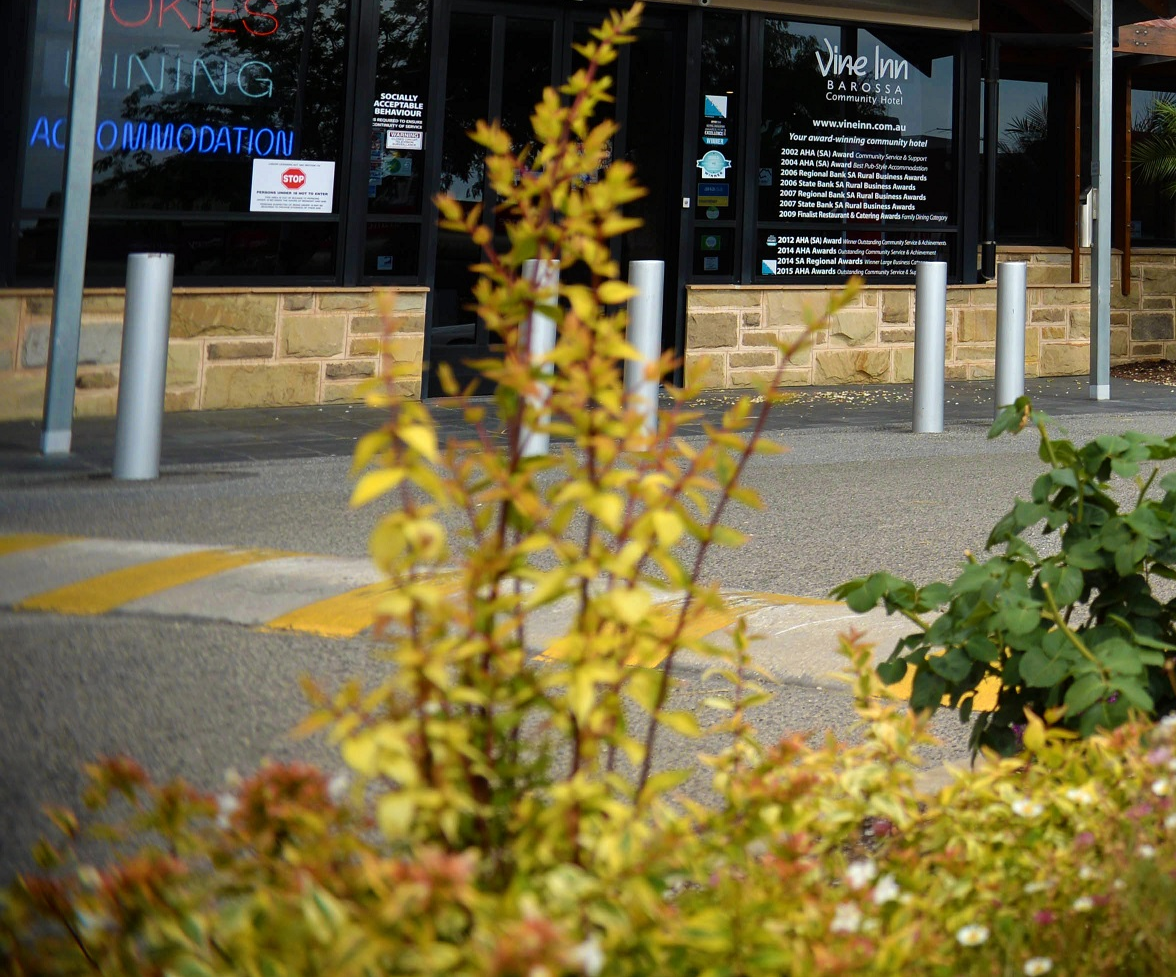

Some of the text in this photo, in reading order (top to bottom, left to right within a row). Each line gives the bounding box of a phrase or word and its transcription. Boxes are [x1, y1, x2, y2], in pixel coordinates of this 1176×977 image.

[815, 38, 909, 80] Vine Inn
[65, 50, 273, 98] INING
[827, 80, 903, 95] BAROSSA
[381, 93, 418, 101] SOCIALLY
[825, 92, 903, 106] Community Hotel
[374, 100, 423, 109] ACCEPTABLE
[375, 108, 421, 117] BEHAVIOUR
[812, 120, 906, 132] www.vineinn.com.au
[29, 116, 294, 156] ACOMMODATION
[789, 133, 928, 147] Your award-winning community hotel
[817, 150, 831, 158] (SA)
[283, 174, 304, 183] STOP
[799, 170, 828, 179] Regional
[798, 191, 827, 199] Regional
